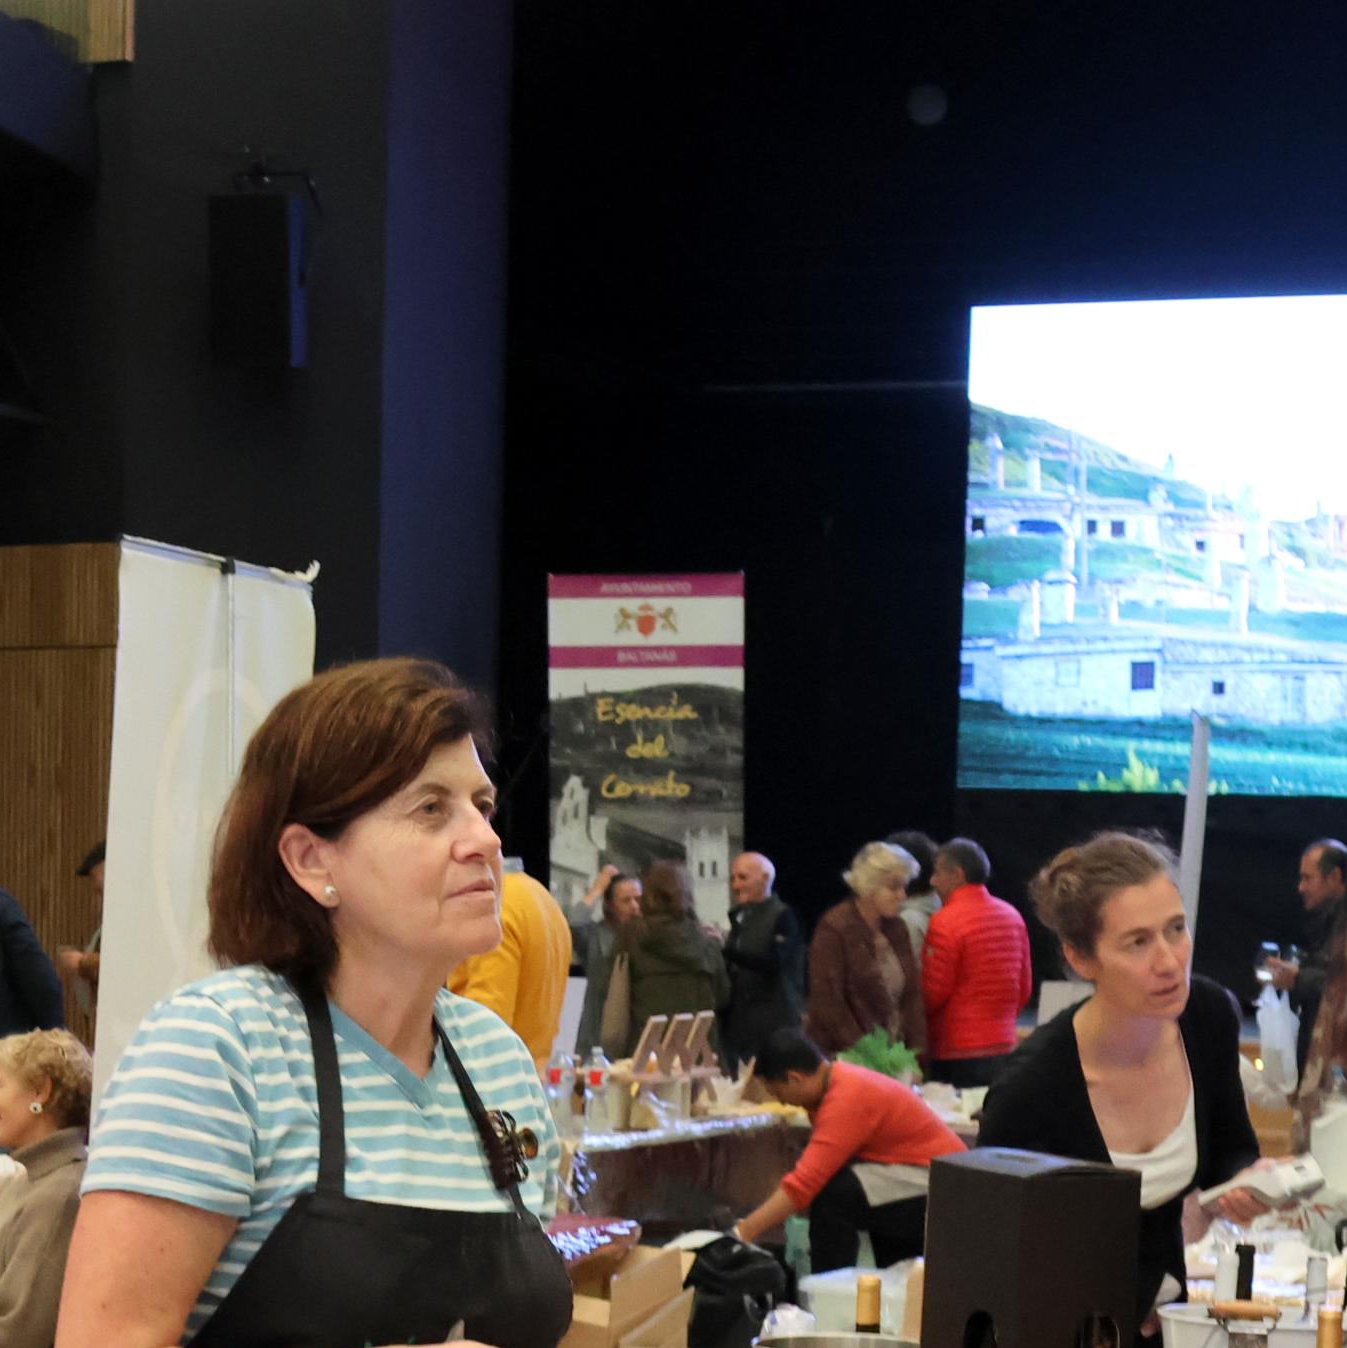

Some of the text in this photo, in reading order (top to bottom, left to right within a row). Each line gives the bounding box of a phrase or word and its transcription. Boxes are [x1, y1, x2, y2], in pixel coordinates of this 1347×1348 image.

[600, 581, 692, 595] AYUNTAMIENTO
[596, 693, 699, 726] Esencia
[625, 731, 669, 759] del
[601, 770, 691, 799] Cerrato
